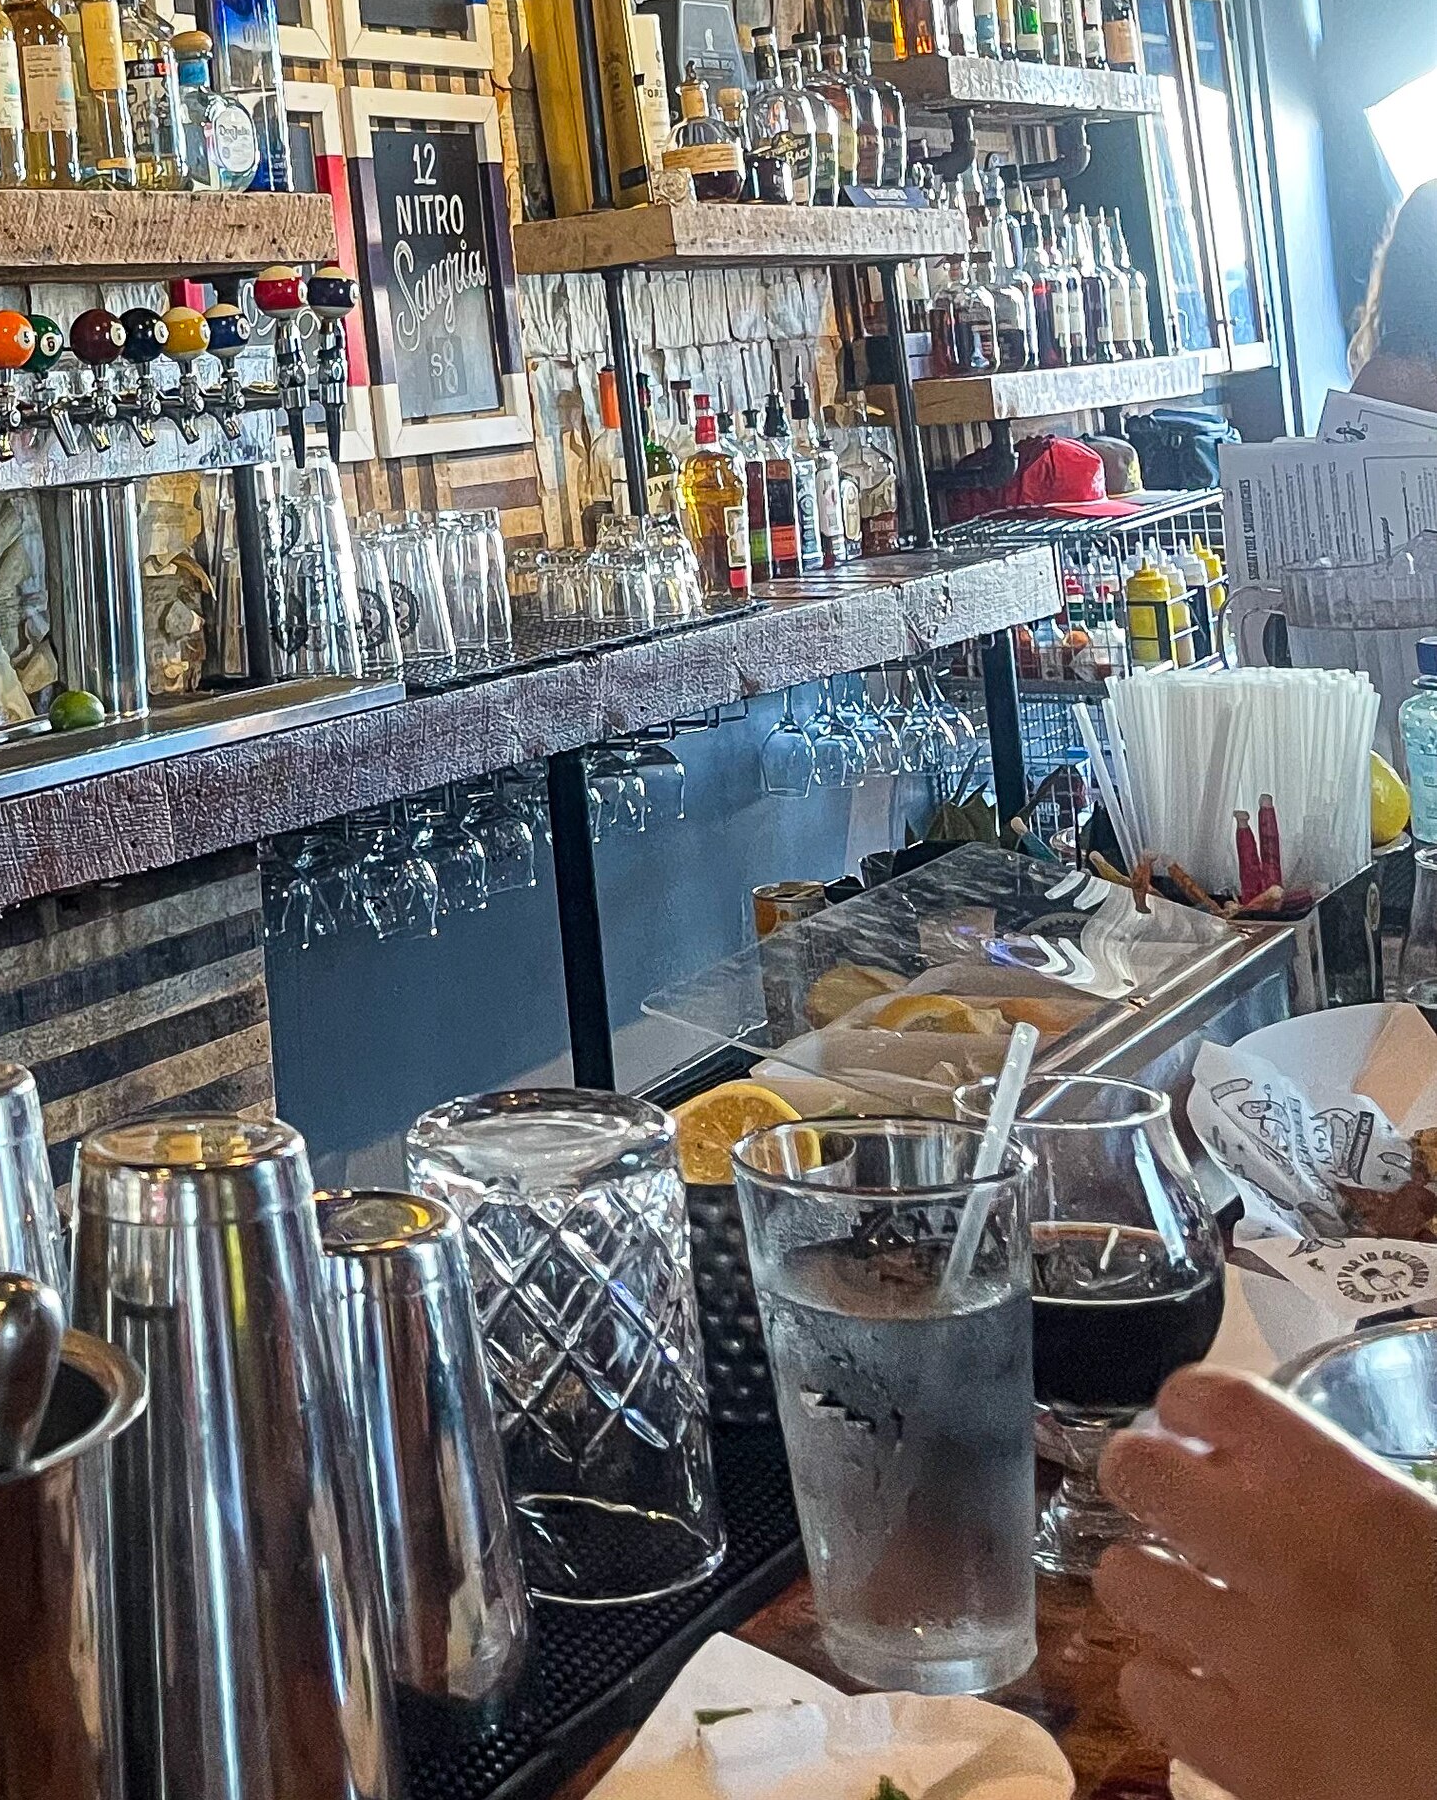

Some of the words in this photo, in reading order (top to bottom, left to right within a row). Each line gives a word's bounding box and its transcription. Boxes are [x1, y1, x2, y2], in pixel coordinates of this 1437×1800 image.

[412, 143, 438, 185] 12
[396, 194, 465, 236] NITRO
[393, 238, 487, 352] Sangria
